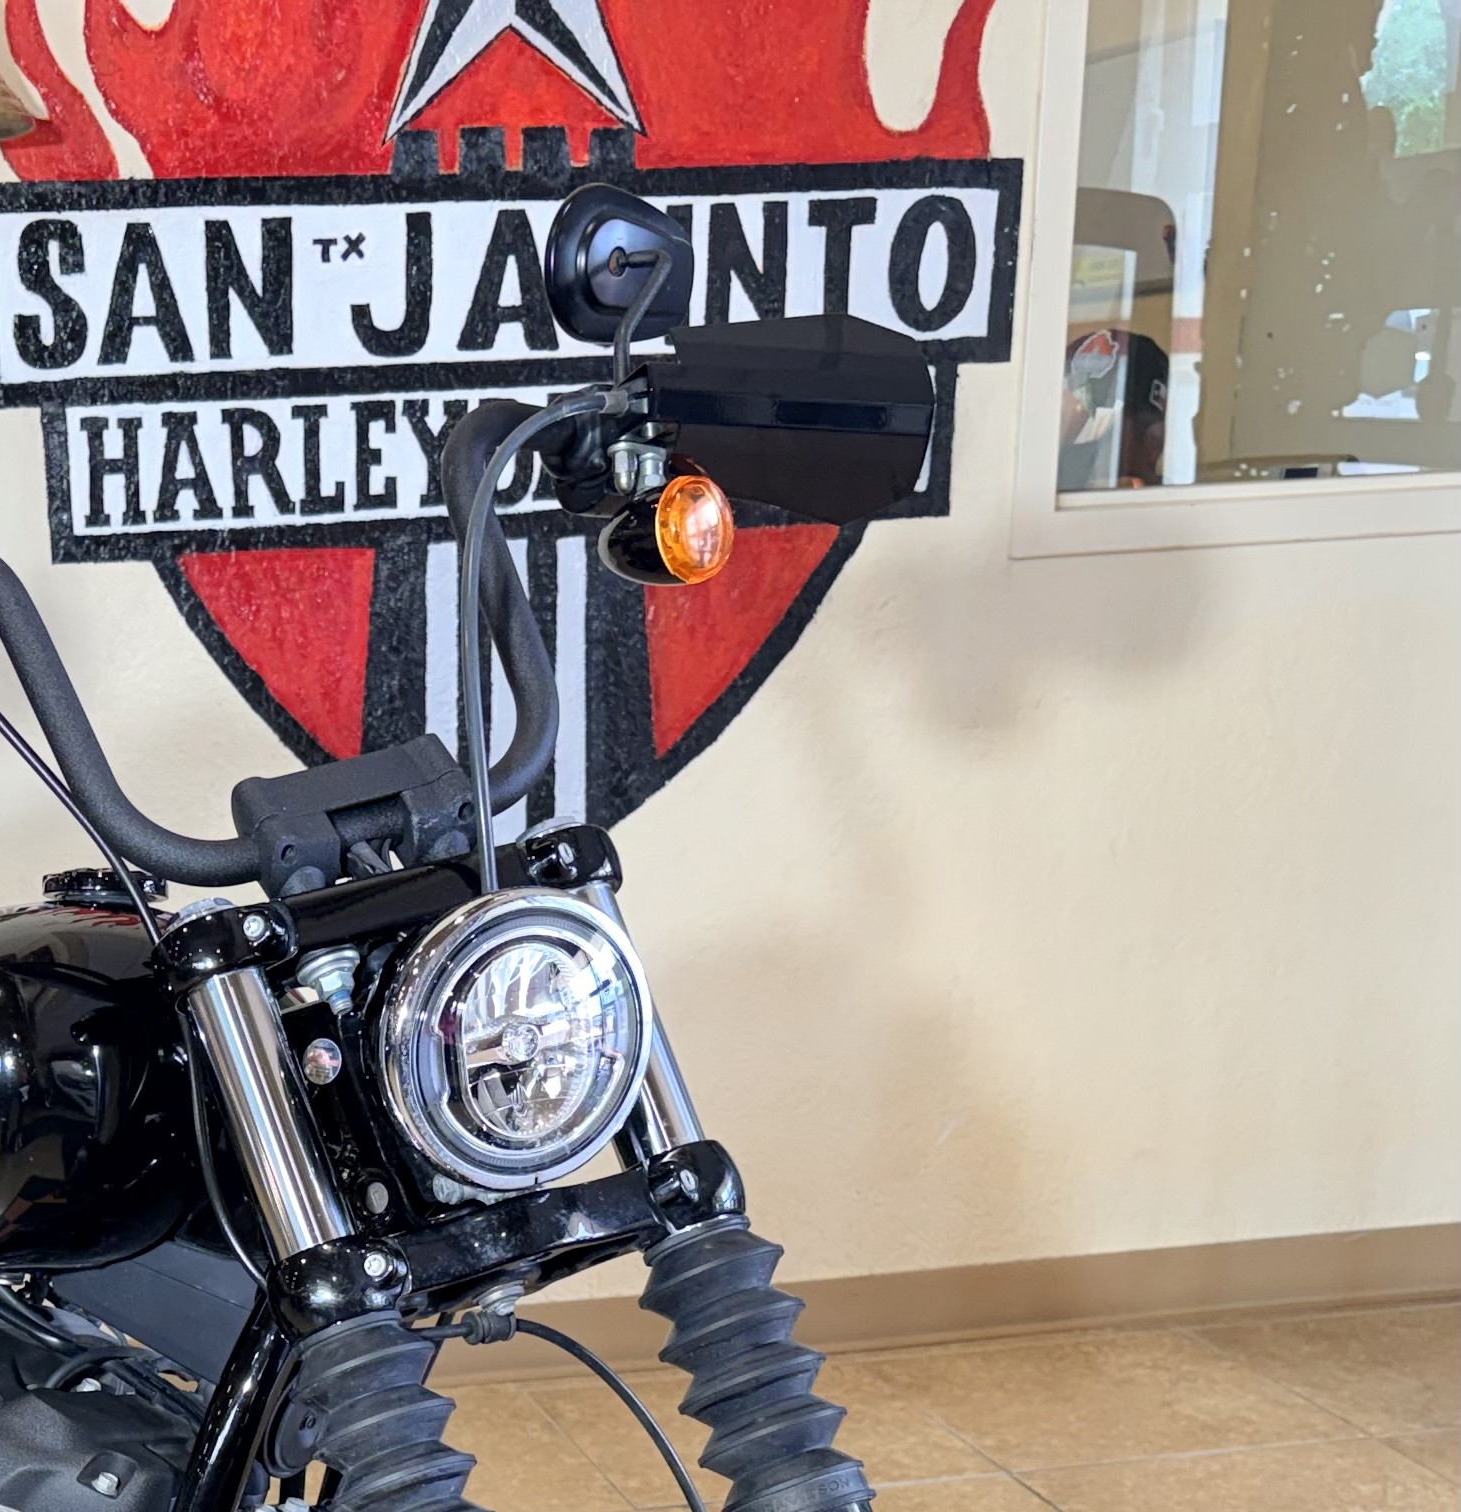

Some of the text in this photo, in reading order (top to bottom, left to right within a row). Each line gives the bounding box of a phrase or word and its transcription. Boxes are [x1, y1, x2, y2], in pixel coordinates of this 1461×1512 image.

[13, 193, 977, 370] SAN JANTO
[313, 231, 366, 264] TX
